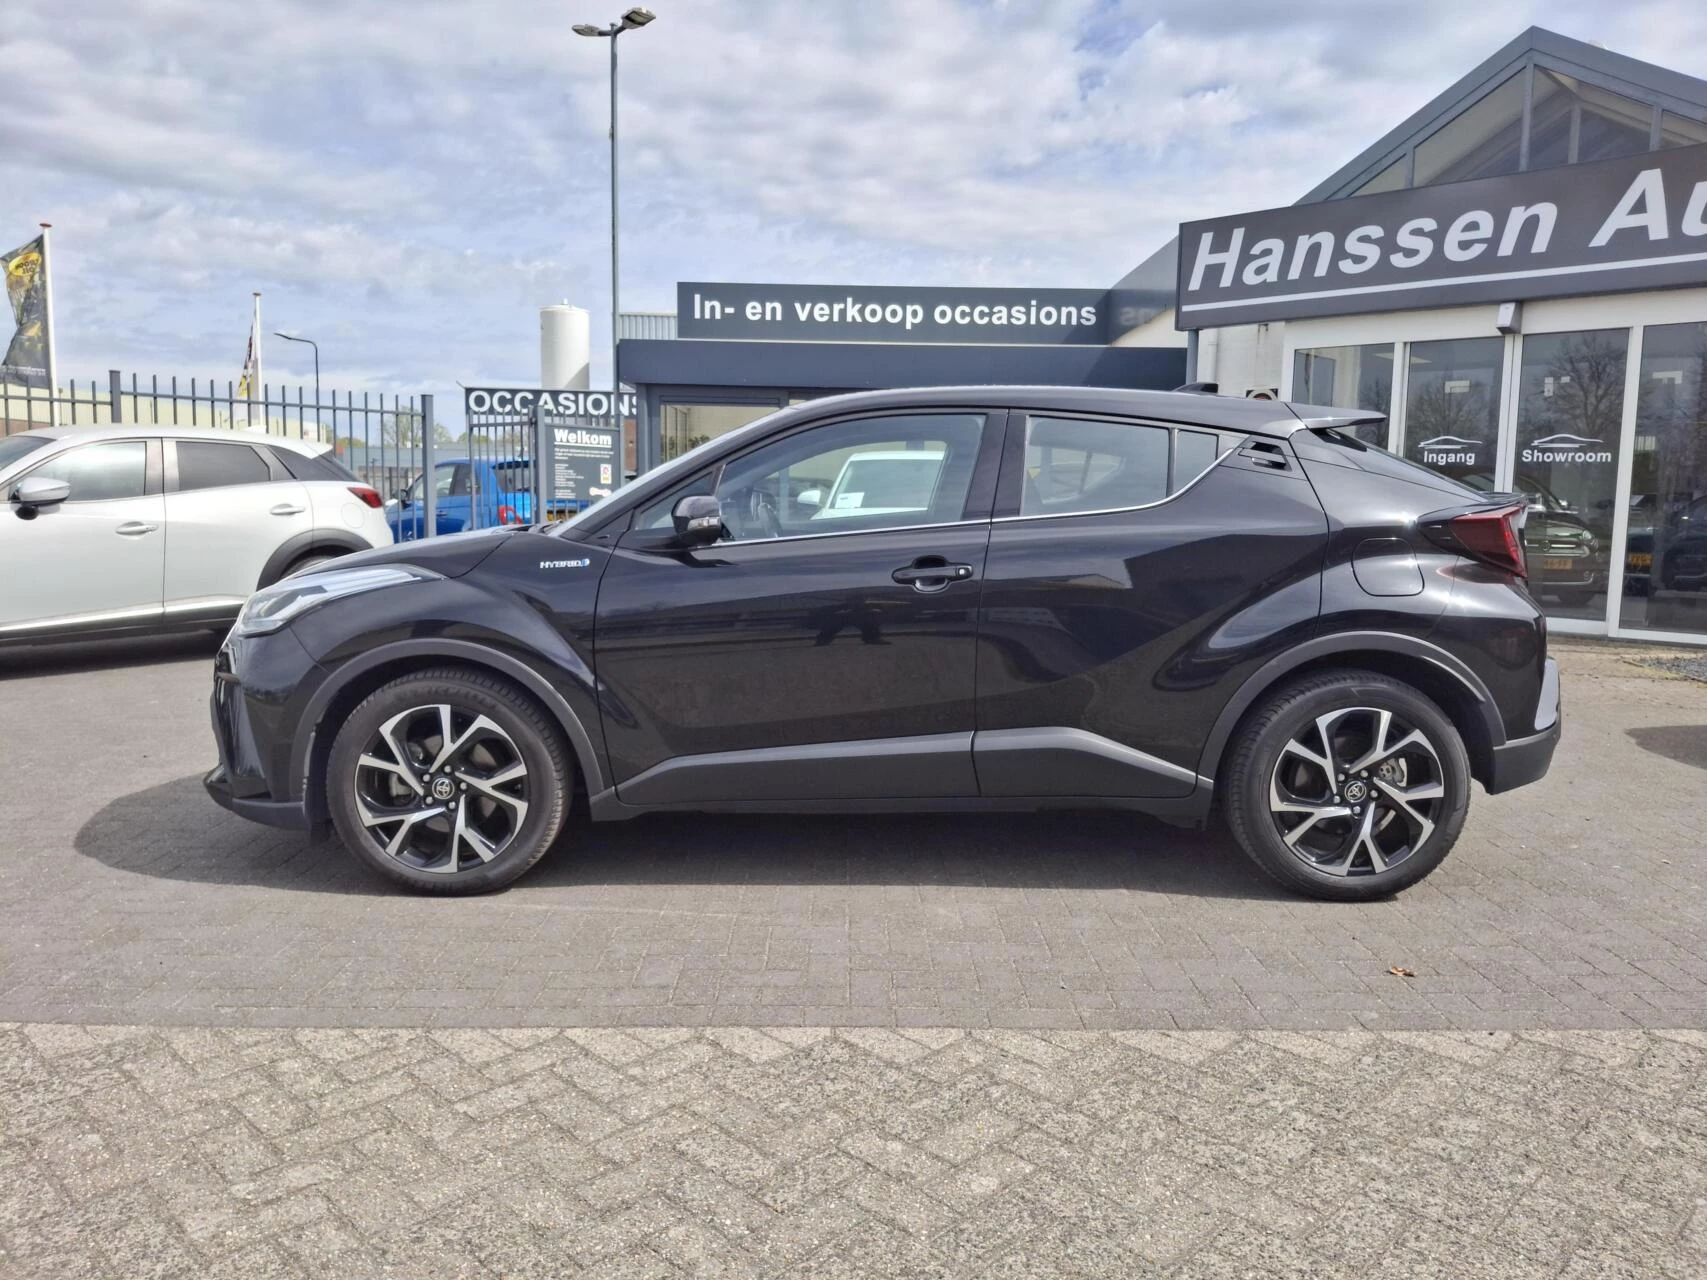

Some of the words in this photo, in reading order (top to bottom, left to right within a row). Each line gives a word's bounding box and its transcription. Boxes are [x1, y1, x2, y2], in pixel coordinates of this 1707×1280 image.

[1188, 199, 1557, 291] Hanssen
[693, 294, 735, 319] In-
[745, 301, 782, 321] en
[794, 298, 924, 330] verkoop
[933, 299, 1097, 326] occasions
[468, 390, 637, 416] OCCASION
[554, 428, 612, 445] Welkom
[1423, 451, 1476, 465] Ingang
[1521, 449, 1612, 463] Showroom
